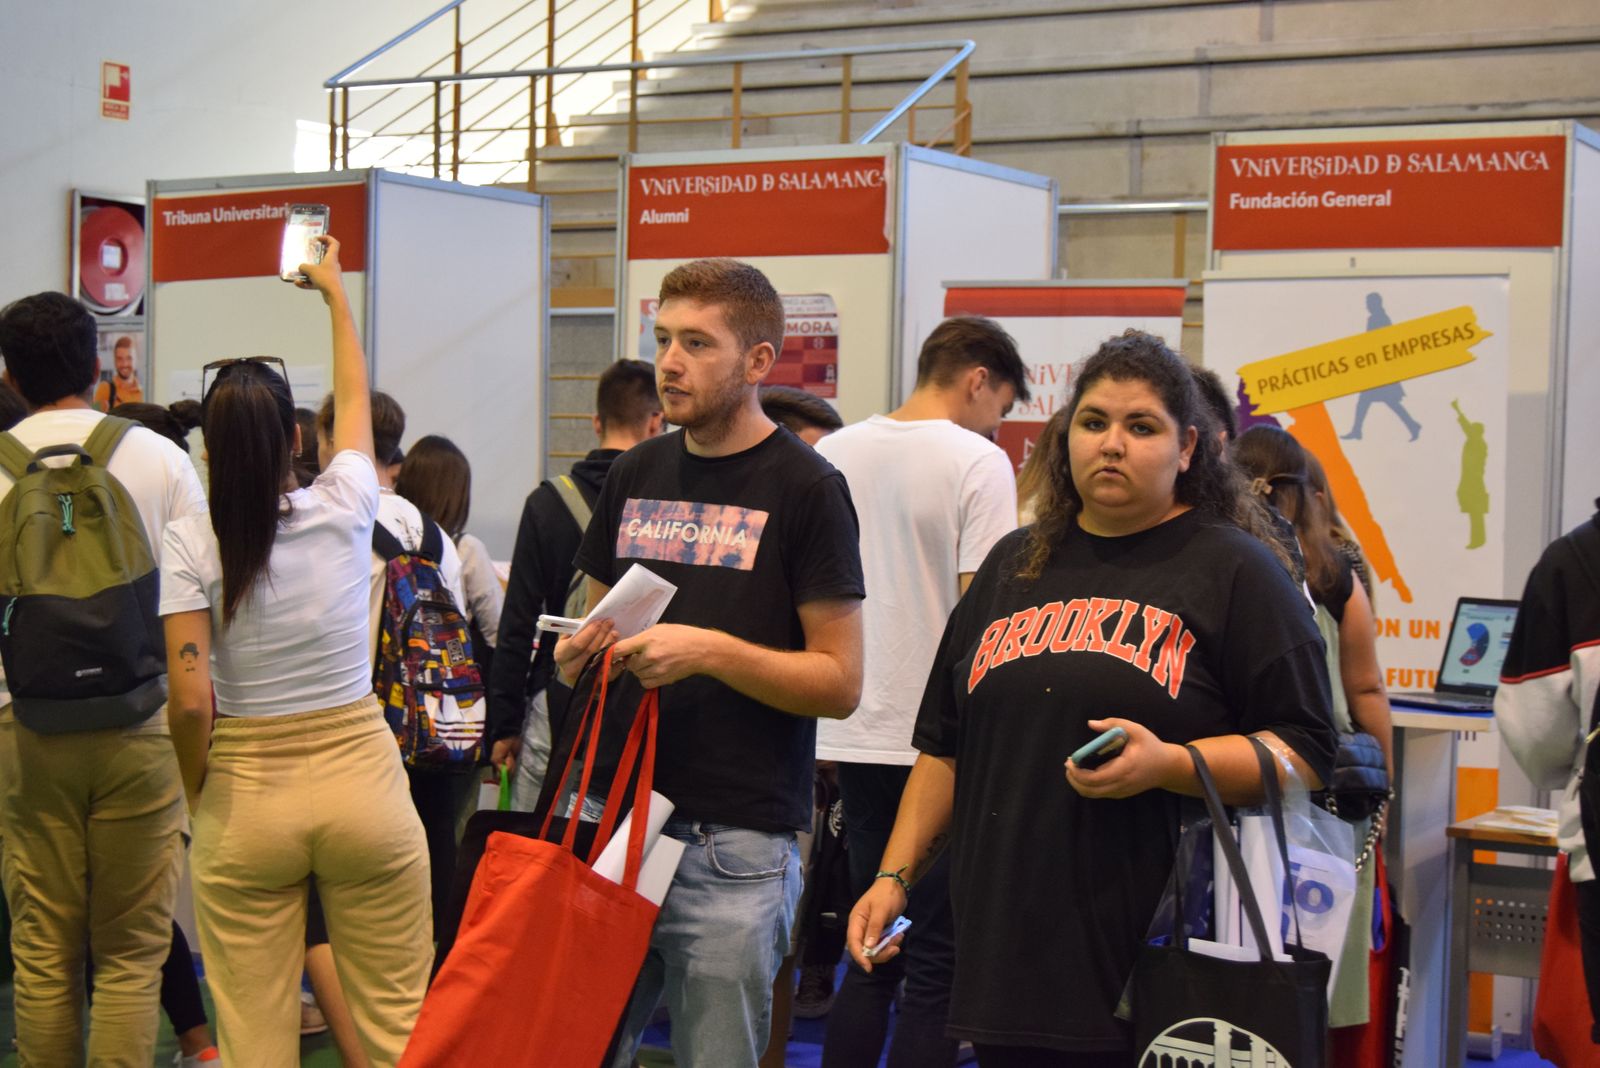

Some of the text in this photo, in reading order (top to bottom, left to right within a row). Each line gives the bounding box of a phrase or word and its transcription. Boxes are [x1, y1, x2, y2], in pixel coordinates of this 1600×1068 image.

[1407, 150, 1550, 174] SALAMANCA
[1229, 189, 1392, 210] Fundación General
[163, 202, 289, 227] Tribuna Universitari
[640, 208, 690, 225] Alumni
[786, 321, 833, 334] MORA
[1257, 322, 1475, 395] PRÁCTICAS en EMPRESAS
[627, 519, 747, 547] CALIFORNIA
[1408, 619, 1441, 640] UN
[967, 596, 1197, 700] BROOKLYN
